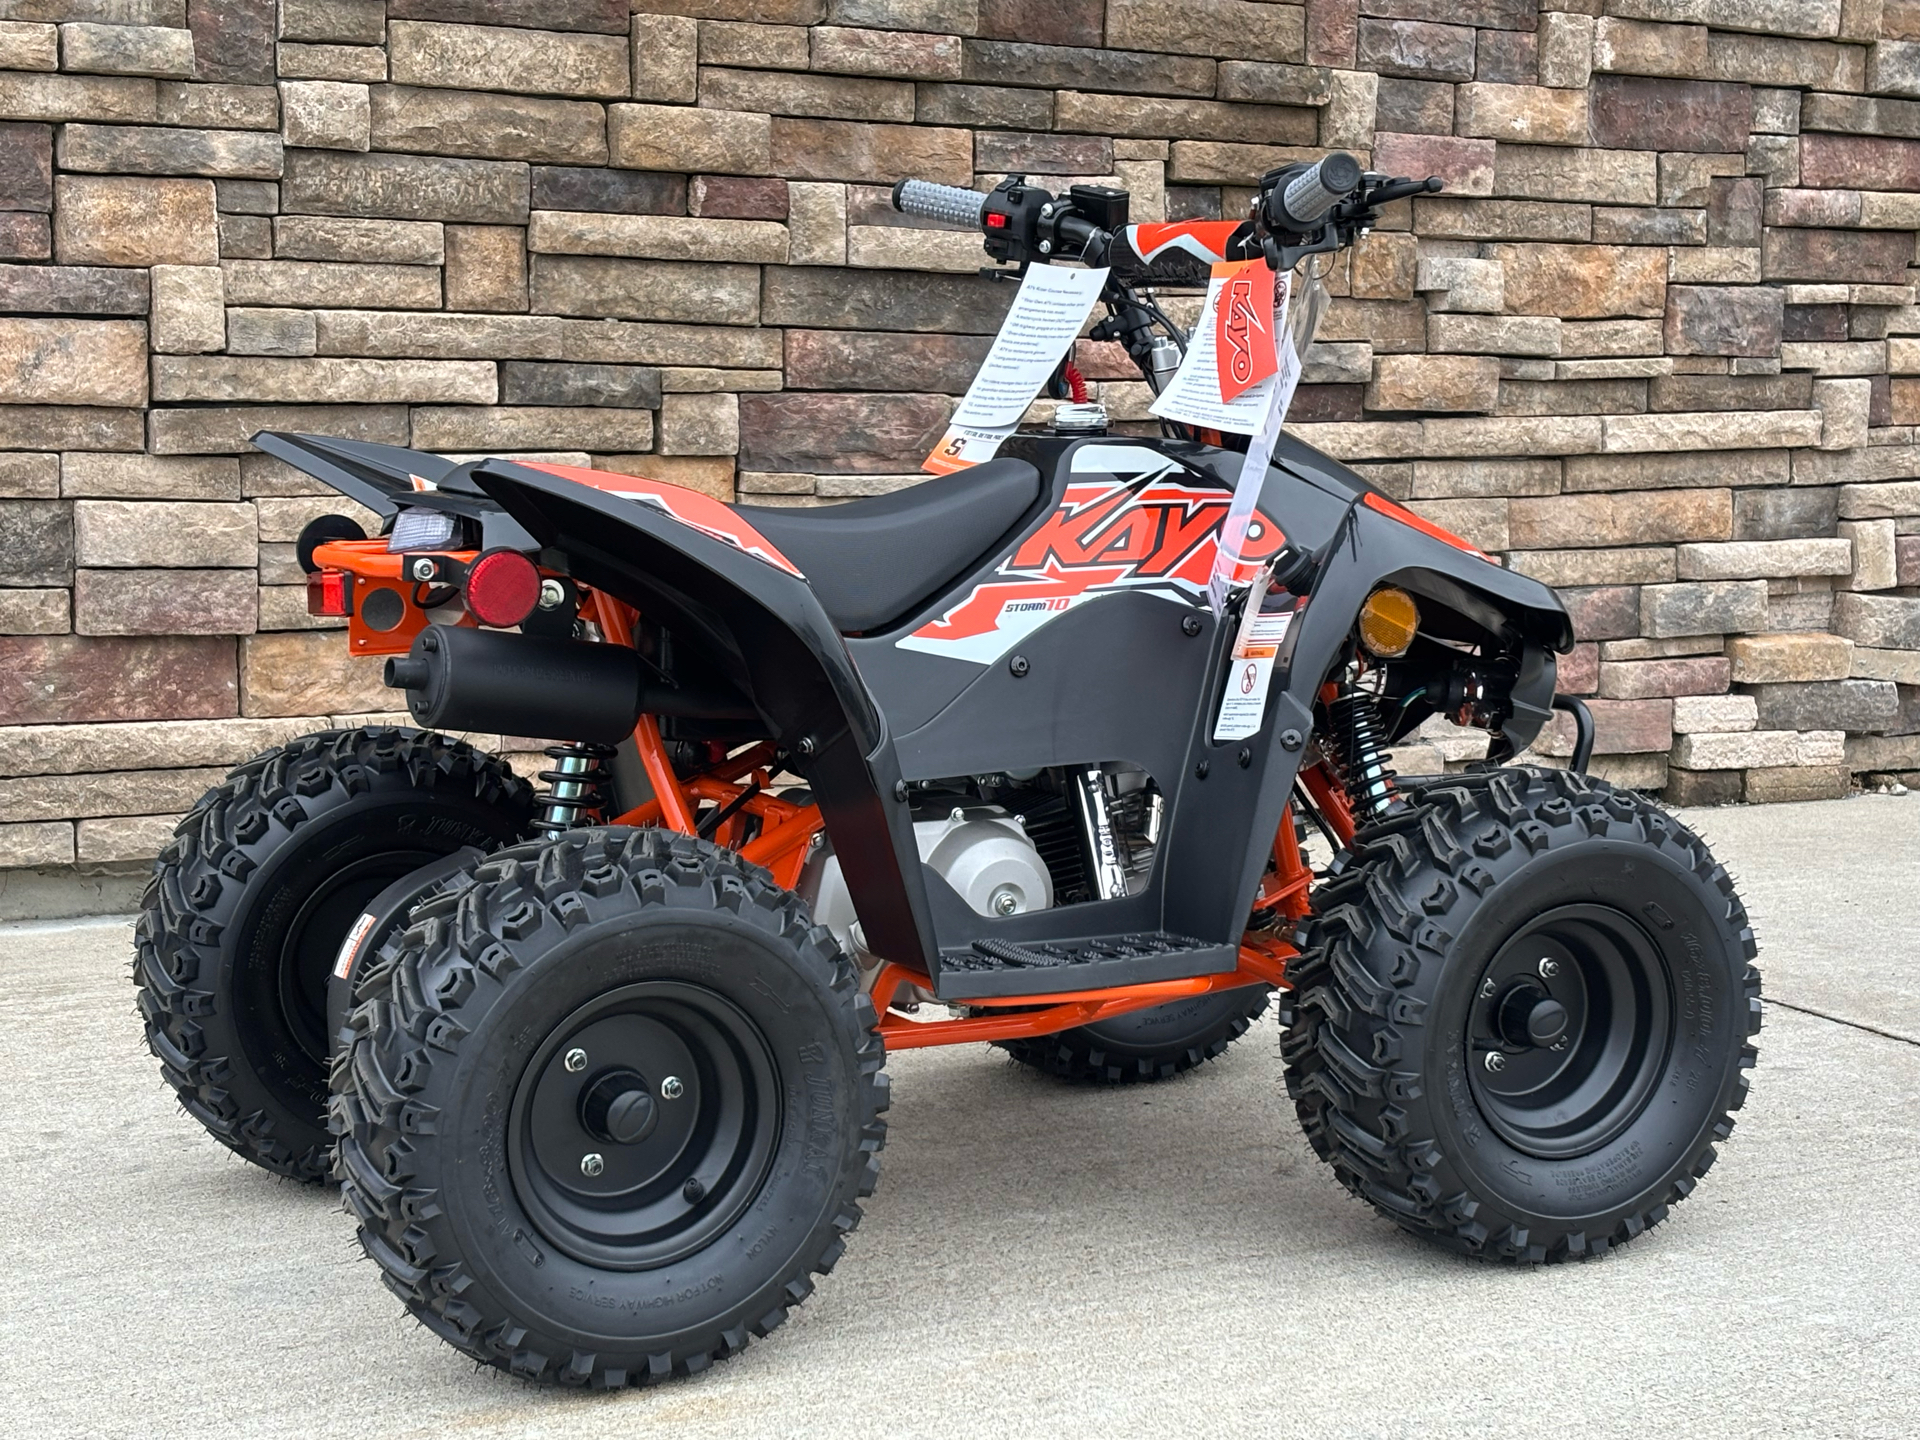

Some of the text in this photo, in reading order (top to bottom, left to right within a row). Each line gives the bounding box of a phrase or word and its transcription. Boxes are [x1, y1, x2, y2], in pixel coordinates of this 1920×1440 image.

[1225, 280, 1266, 384] KAYO
[1000, 482, 1289, 579] KAYO
[1005, 598, 1071, 613] STORM 70
[1142, 1012, 1176, 1026] SERVICE
[801, 1070, 835, 1178] JUNKAI
[745, 1224, 780, 1261] NYLON
[568, 1272, 725, 1311] NOT FOR HIGHWAY SERVICE
